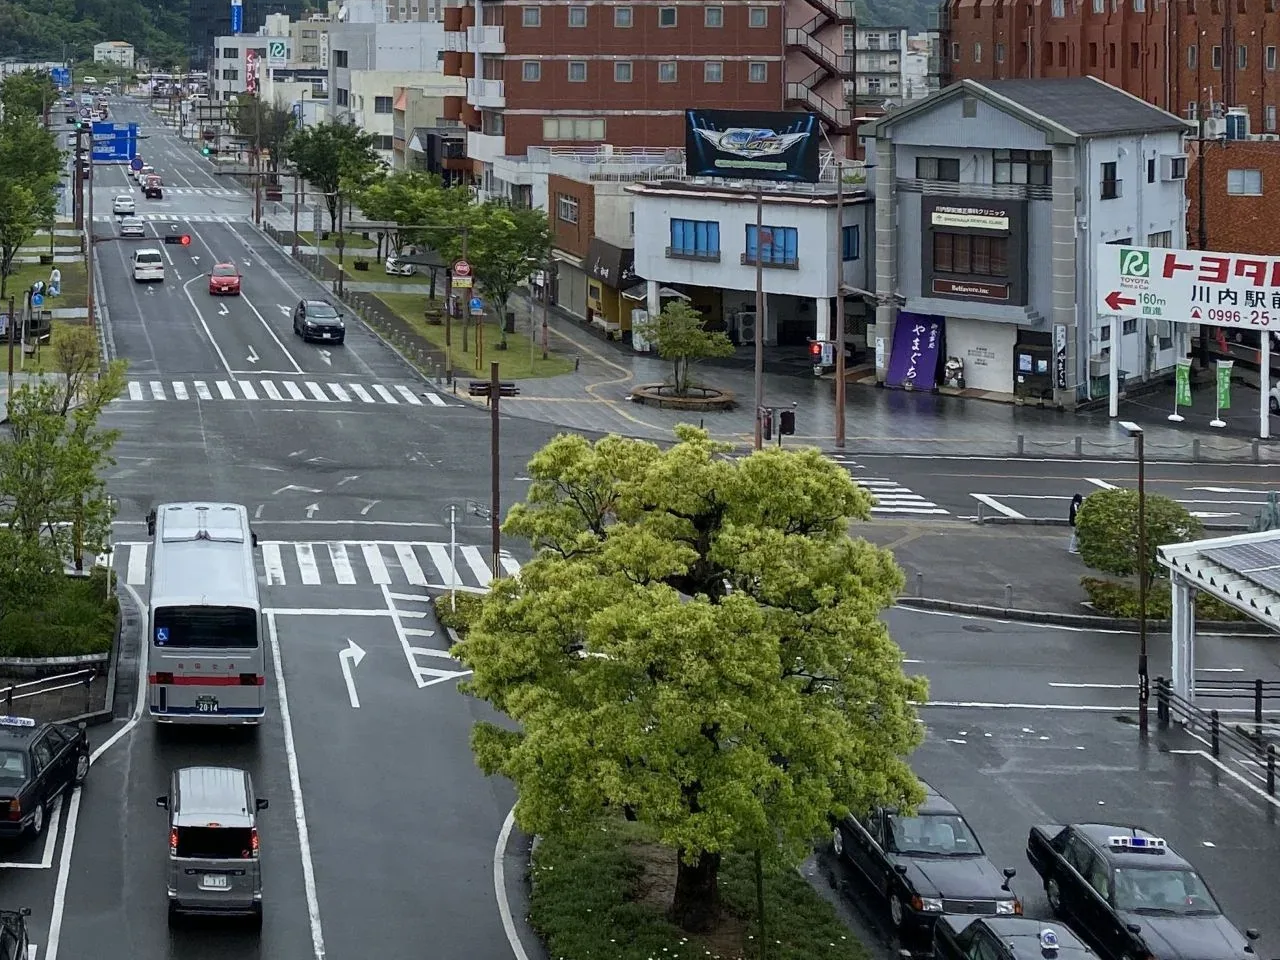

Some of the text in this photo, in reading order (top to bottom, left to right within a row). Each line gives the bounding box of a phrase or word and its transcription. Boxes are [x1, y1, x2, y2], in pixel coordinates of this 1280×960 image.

[1120, 276, 1150, 285] TOYOTA
[1138, 292, 1166, 306] 160m
[1142, 306, 1162, 316] 直進
[1208, 308, 1280, 326] 0996-25-
[906, 324, 926, 379] やまぐち
